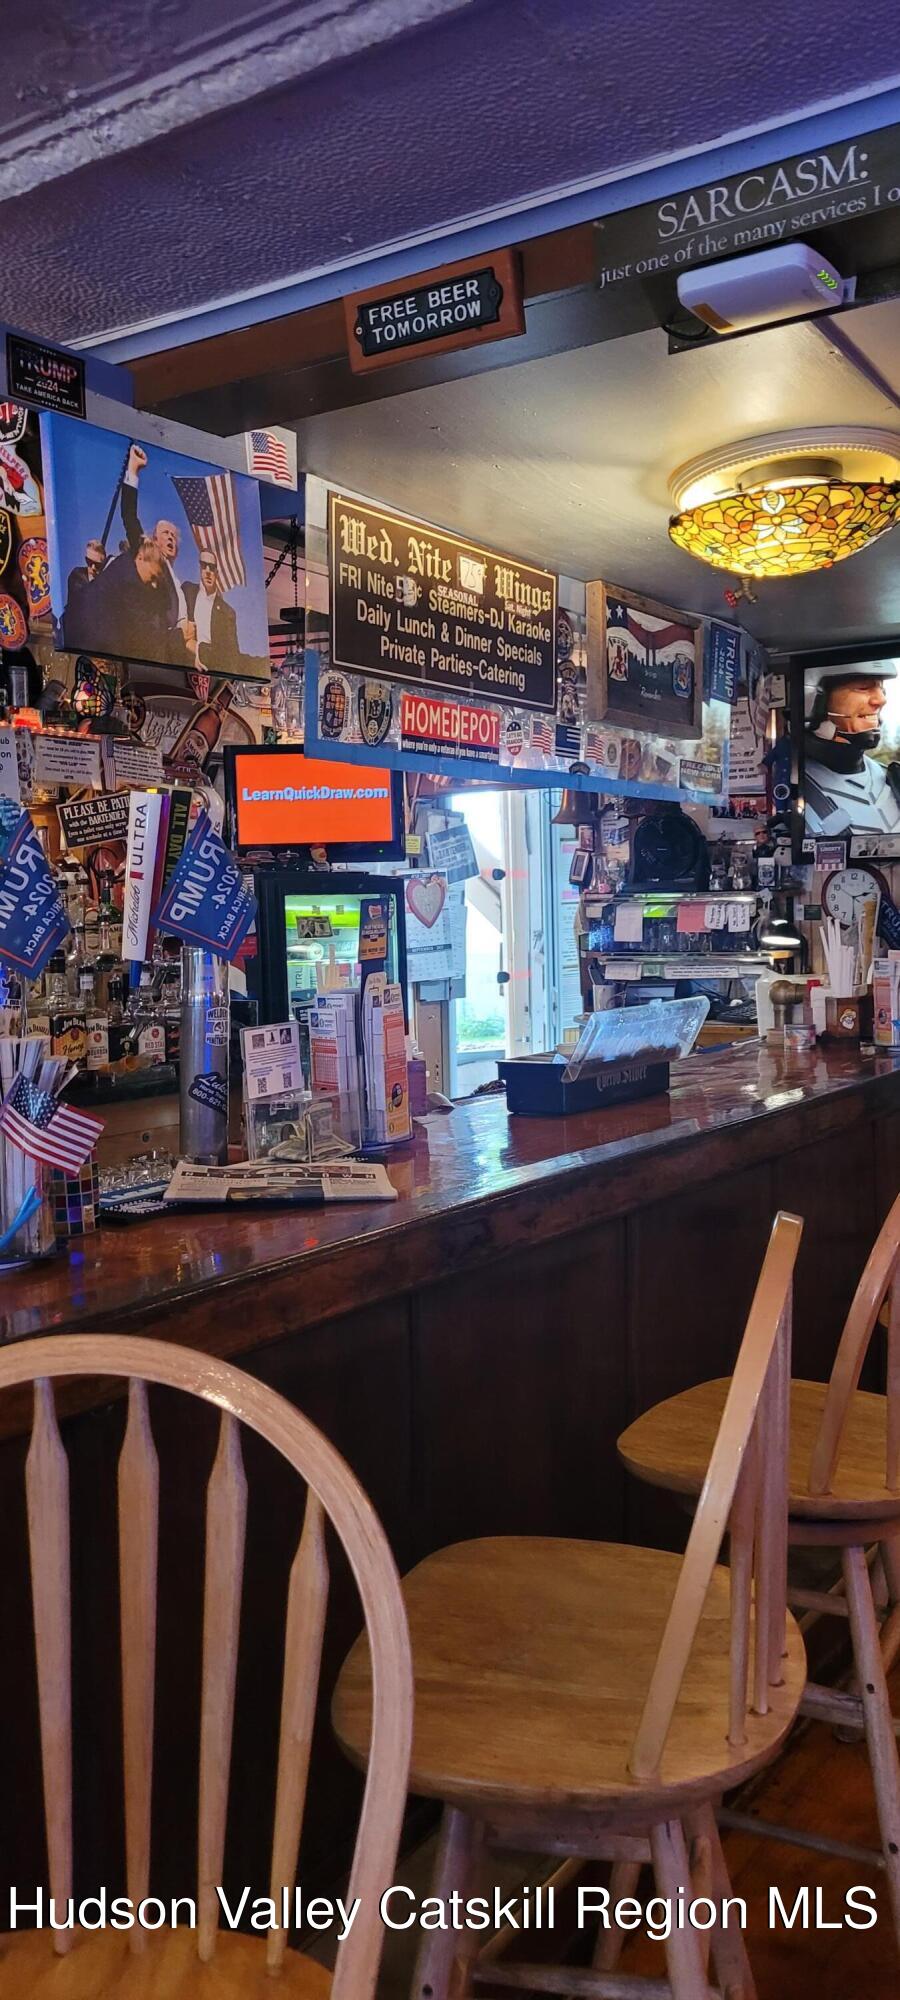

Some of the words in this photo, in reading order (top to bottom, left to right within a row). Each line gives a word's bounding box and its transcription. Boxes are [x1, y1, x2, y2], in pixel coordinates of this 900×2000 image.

[657, 145, 868, 238] SARCASM:
[599, 263, 632, 289] just
[636, 251, 670, 274] one
[673, 236, 696, 263] of
[698, 234, 728, 256] the
[733, 217, 787, 246] many
[791, 195, 867, 230] services
[368, 297, 418, 326] FREE
[428, 279, 480, 309] BEER
[372, 300, 481, 344] TOMORROW
[16, 346, 78, 384] TRUMP
[15, 382, 33, 394] TAKE
[33, 389, 61, 403] AMERICA
[62, 398, 79, 409] BACK
[339, 514, 400, 568] Wed.
[407, 536, 452, 584] Nite
[494, 564, 552, 617] Wings
[339, 562, 361, 590] FRI
[367, 574, 395, 599] Nite
[508, 612, 551, 643] Karaoke
[436, 584, 479, 607] SEASONAL
[356, 598, 392, 632] Daily
[396, 609, 436, 640] Lunch
[440, 621, 450, 643] &
[455, 626, 493, 654] Dinner
[496, 636, 543, 667] Specials
[380, 636, 426, 667] Private
[723, 637, 737, 698] TRUMP
[404, 700, 498, 744] HOMEDEPOT
[63, 801, 97, 820] PLEASE
[96, 799, 111, 813] BE
[172, 803, 187, 829] ALL
[242, 786, 389, 802] LearnQuickDraw.com
[88, 809, 128, 826] BARTENDER
[132, 803, 148, 867] ULTRA
[168, 833, 184, 860] DAY
[126, 885, 141, 947] Michelob
[62, 1042, 84, 1055] Honey
